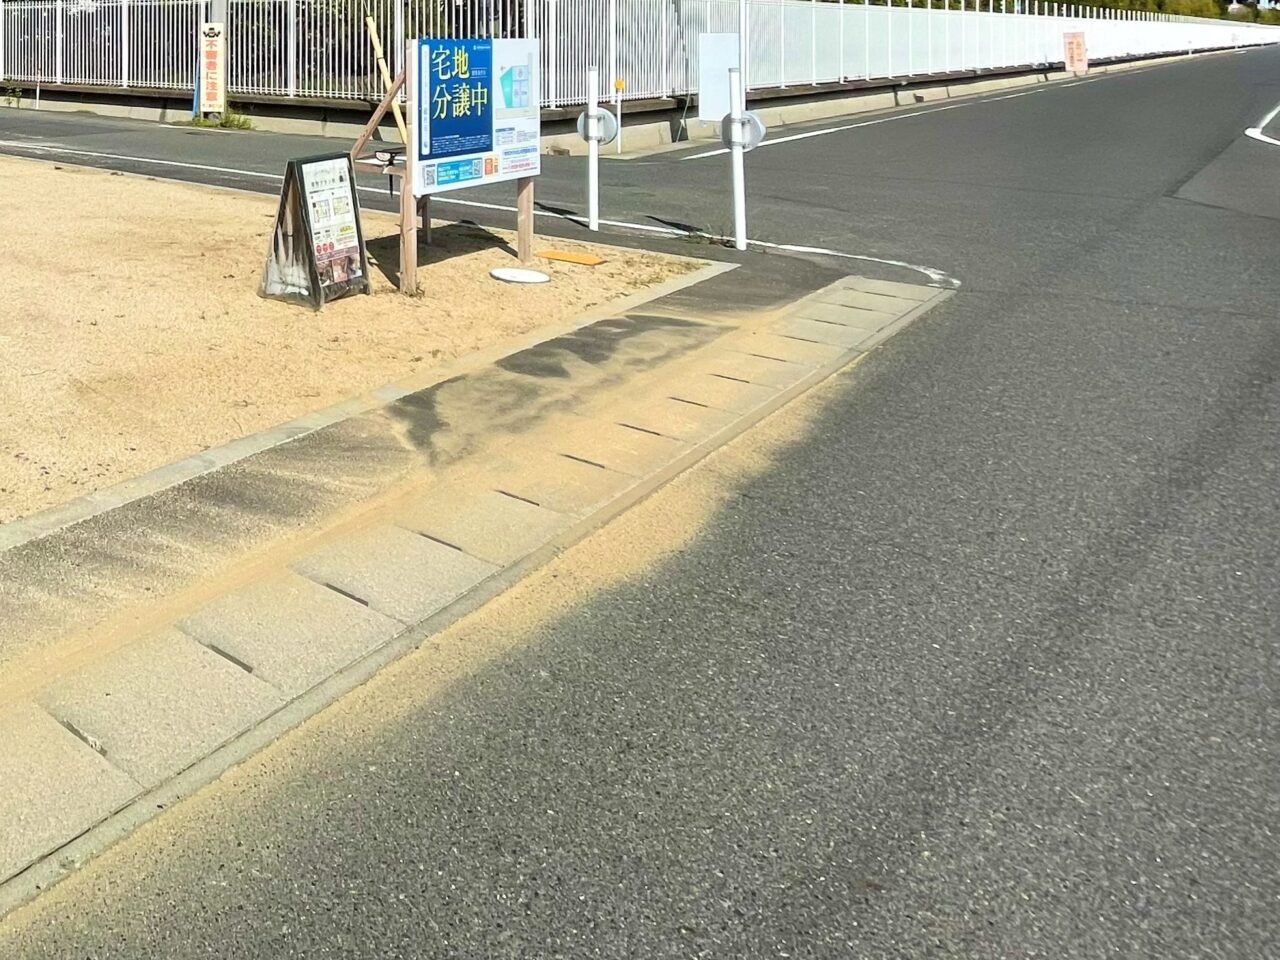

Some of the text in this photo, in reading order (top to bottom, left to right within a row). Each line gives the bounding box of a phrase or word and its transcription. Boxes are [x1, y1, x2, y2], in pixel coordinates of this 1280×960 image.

[206, 39, 218, 101] 不審者に注意
[432, 44, 470, 80] 宅地
[432, 81, 488, 120] 分譲中
